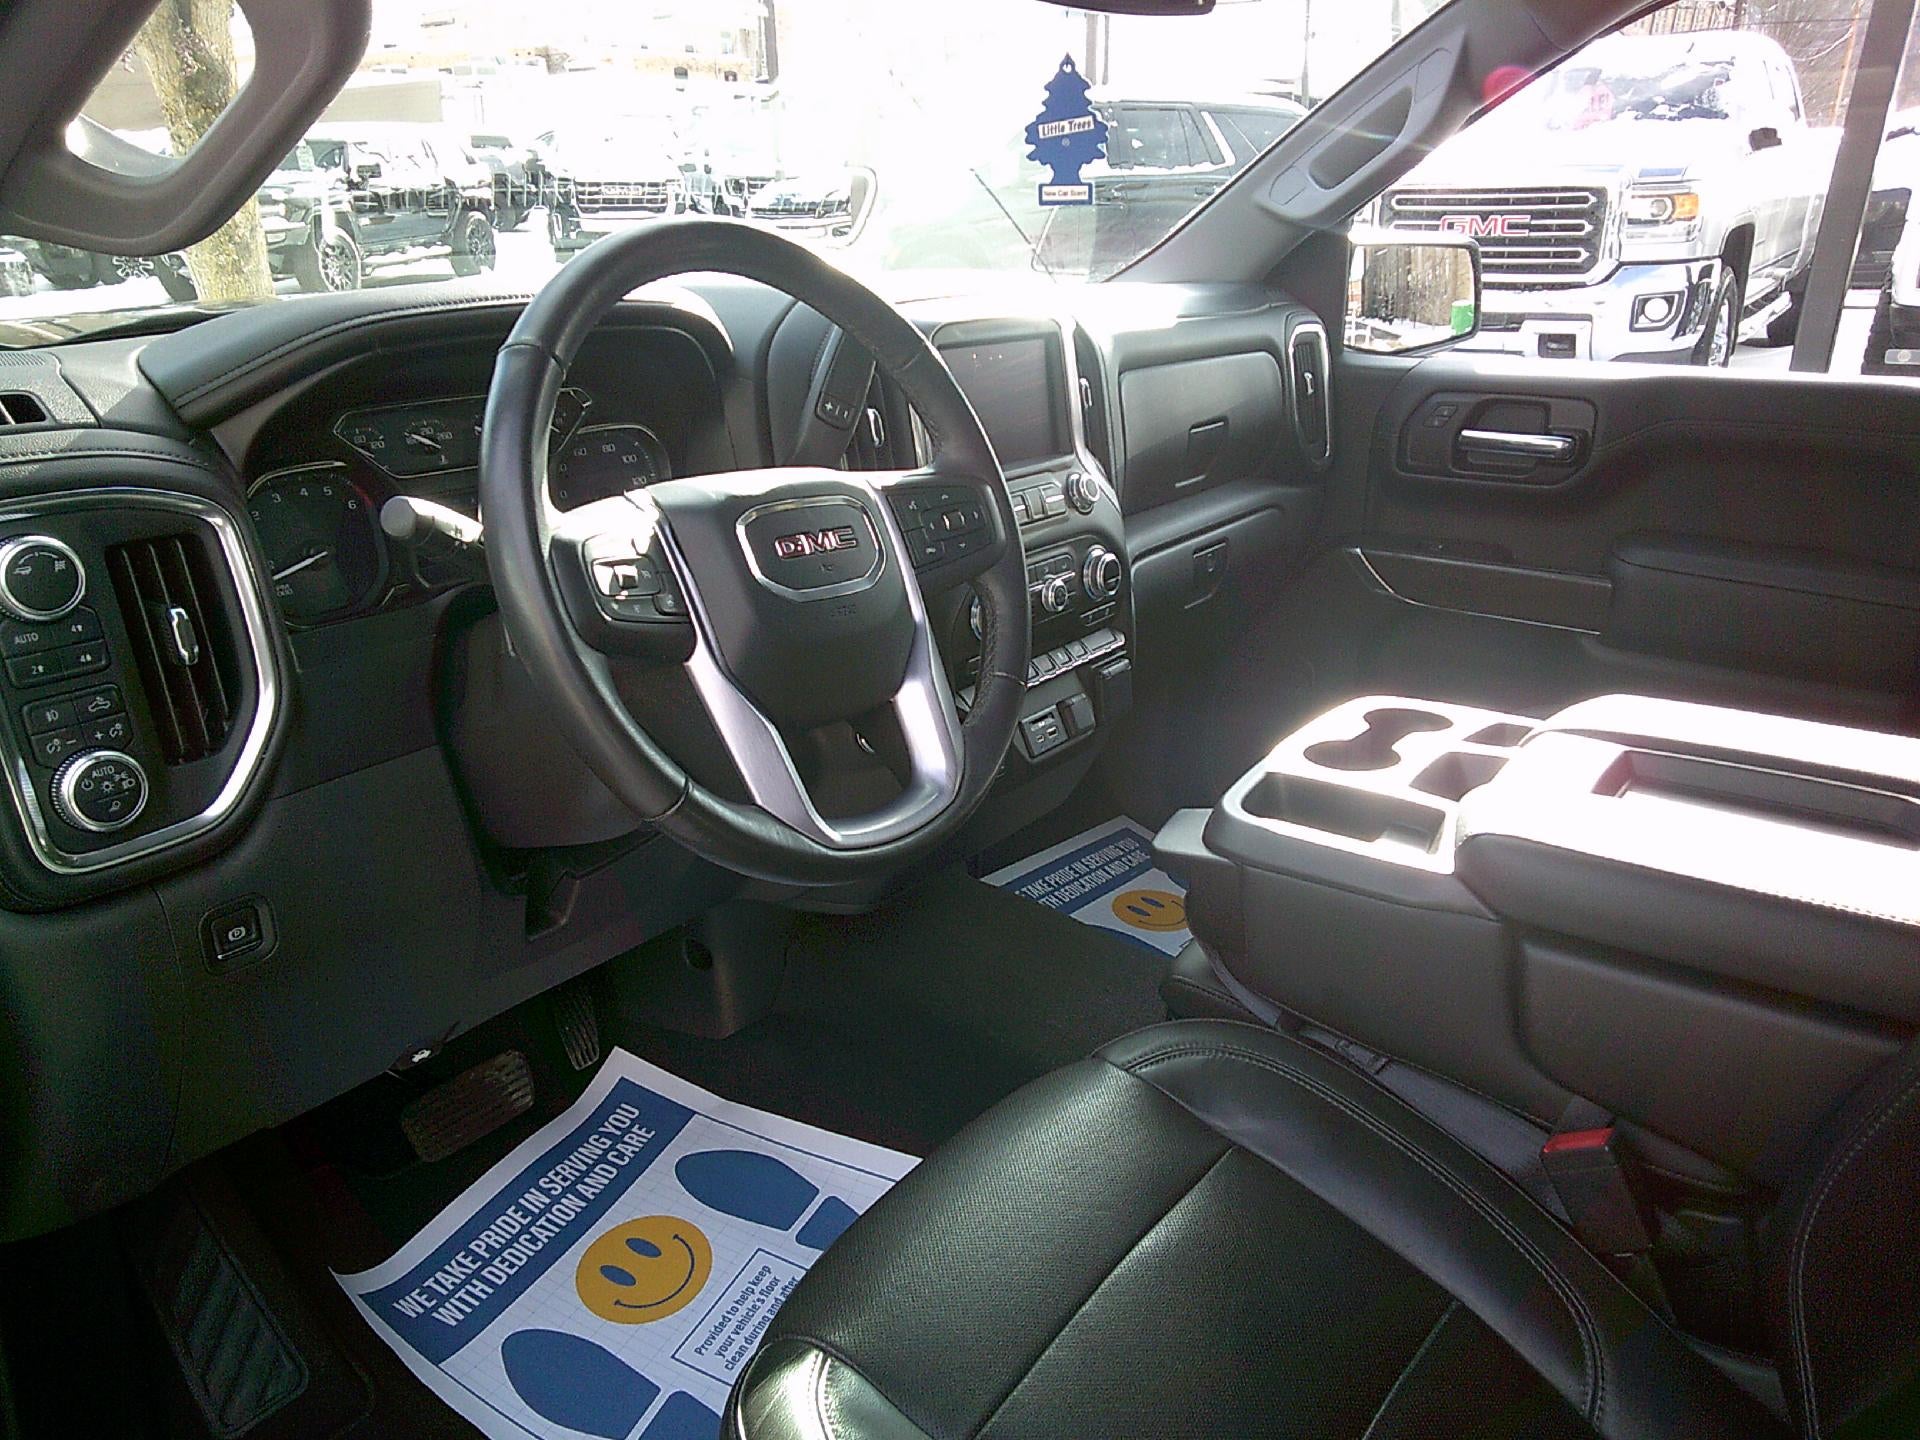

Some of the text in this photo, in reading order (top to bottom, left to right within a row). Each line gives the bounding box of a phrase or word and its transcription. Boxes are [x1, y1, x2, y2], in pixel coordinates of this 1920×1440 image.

[1042, 119, 1092, 136] Little Trees
[1440, 214, 1531, 237] GMC
[602, 443, 615, 453] 80
[622, 454, 637, 464] 100
[272, 493, 281, 503] 3
[300, 487, 309, 497] 4
[323, 486, 332, 496] 5
[348, 499, 357, 509] 6
[774, 525, 858, 559] GMC
[14, 632, 39, 645] AUTO
[92, 765, 115, 779] AUTO
[1022, 837, 1140, 899] TAKE PRIDE IN SERVING YOU
[1057, 869, 1112, 901] DEDICATION
[1105, 860, 1127, 877] AND
[1123, 850, 1151, 867] CARE
[392, 1103, 640, 1319] WE TAKE PRIDE IN SERVING YOU
[431, 1123, 655, 1327] WITH DEDICATION AND CARE
[694, 1265, 772, 1356] Provided to help keep
[714, 1275, 781, 1359] your vehicle's floor
[724, 1276, 799, 1371] clean during and after
